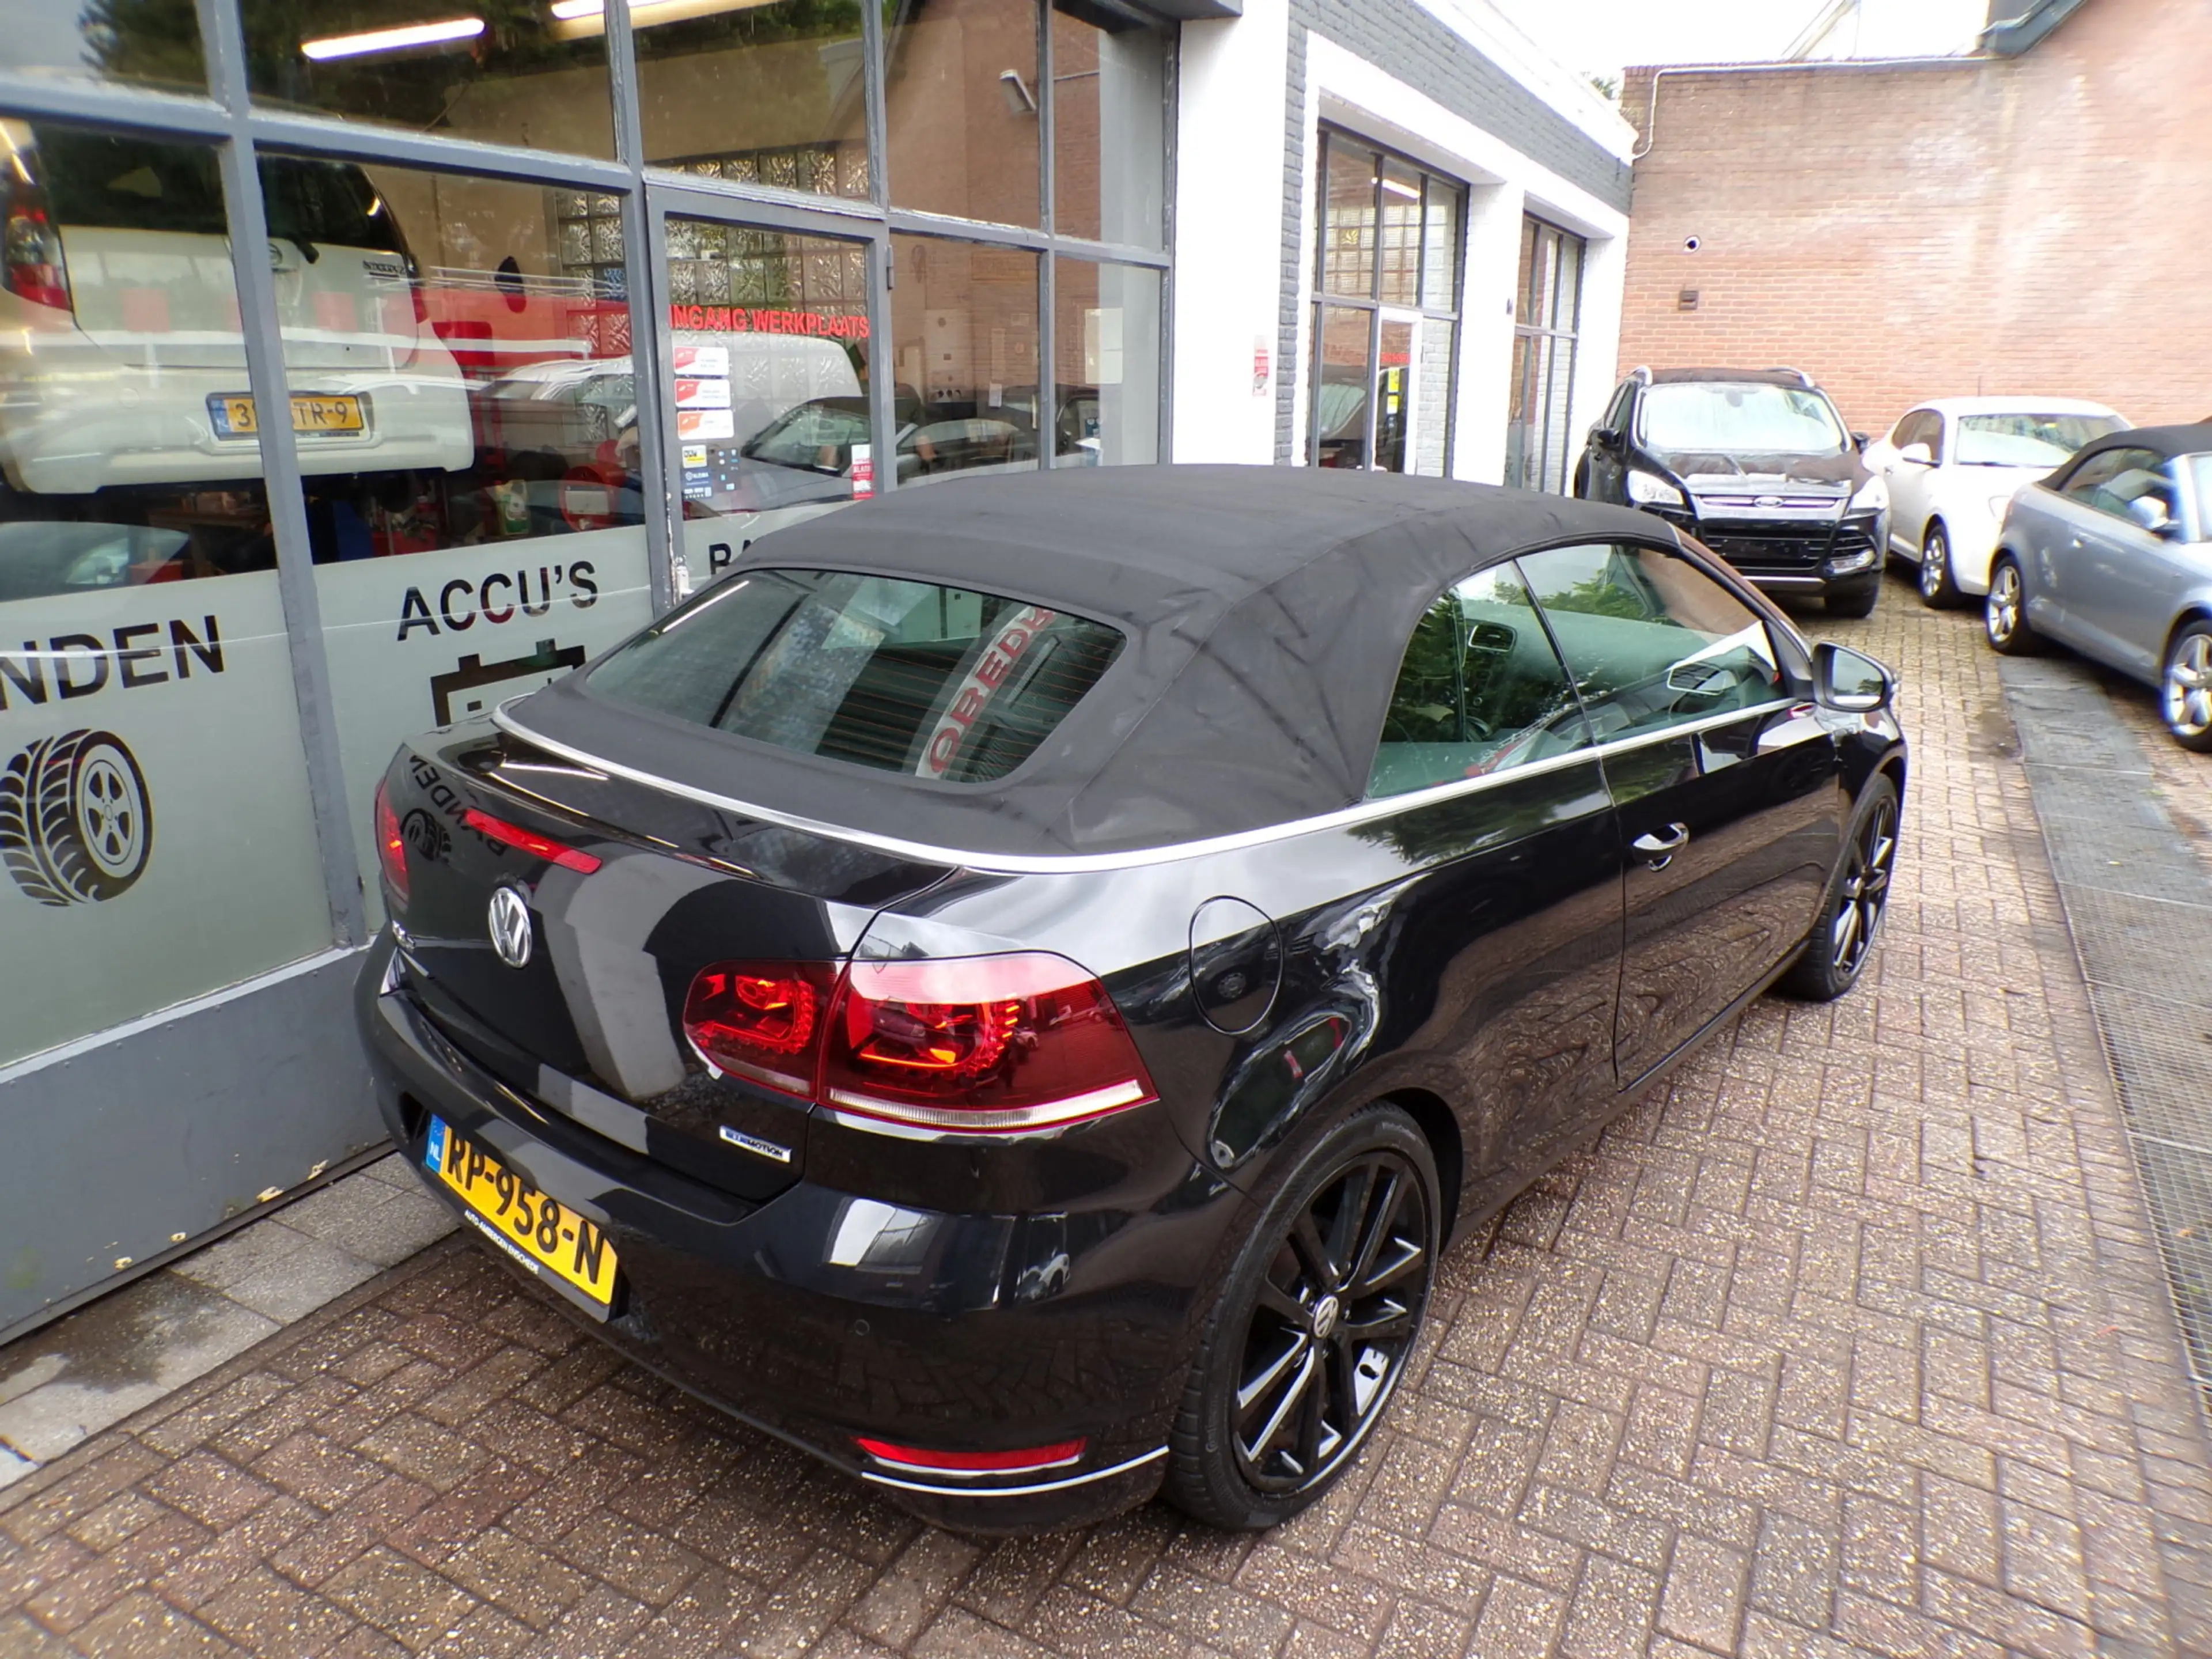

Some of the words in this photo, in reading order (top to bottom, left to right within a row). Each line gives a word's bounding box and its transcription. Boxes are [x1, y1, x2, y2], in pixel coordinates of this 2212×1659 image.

[669, 304, 748, 331] INGANG
[751, 308, 871, 338] WERKPLAATS
[397, 560, 598, 641] ACCU'S
[0, 615, 225, 711] NDEN
[447, 1127, 604, 1285] RP-958-N
